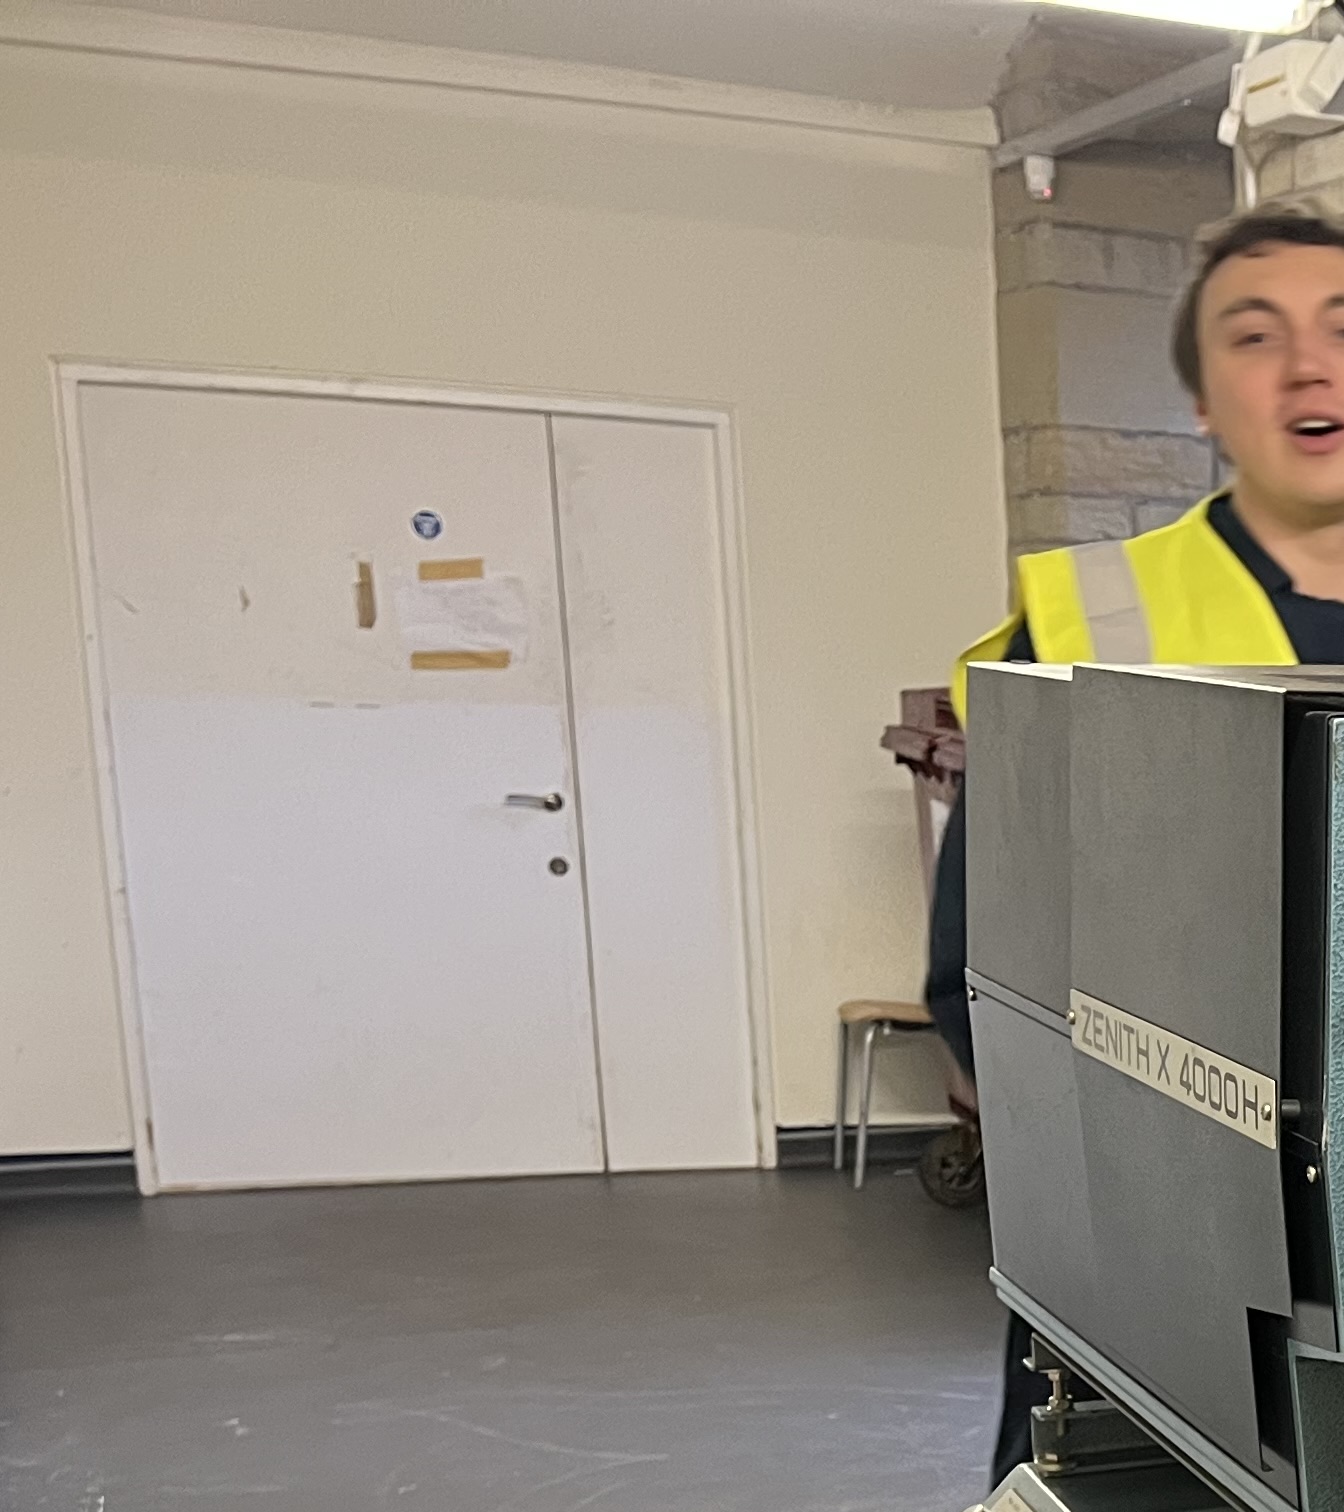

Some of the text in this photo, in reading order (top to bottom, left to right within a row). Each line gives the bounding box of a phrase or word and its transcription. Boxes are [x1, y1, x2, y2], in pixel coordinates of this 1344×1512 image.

[1080, 1004, 1260, 1131] ZENITH X 4000H
